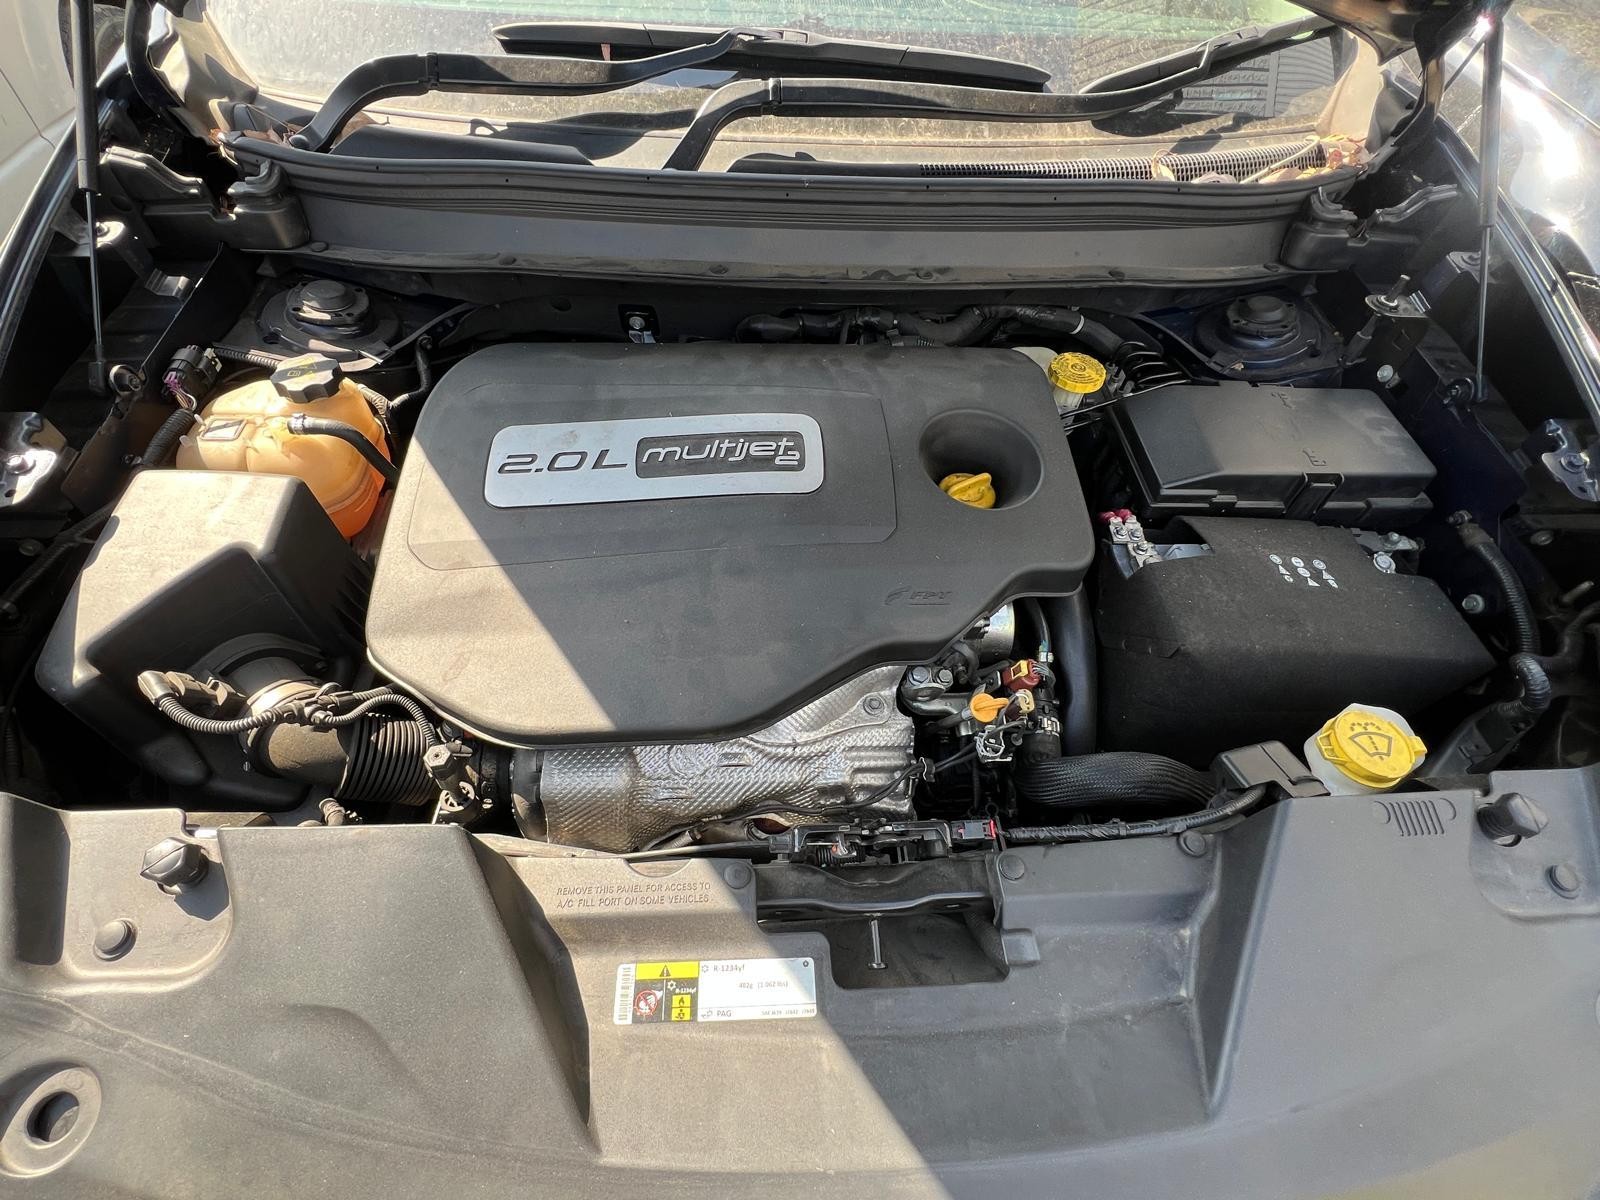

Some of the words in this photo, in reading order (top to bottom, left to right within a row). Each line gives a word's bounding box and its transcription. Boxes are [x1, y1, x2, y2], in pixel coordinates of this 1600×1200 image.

[498, 450, 627, 474] 2.0L
[641, 438, 794, 462] multijet
[556, 886, 593, 896] REMOVE
[595, 885, 614, 895] THIS
[616, 884, 643, 894] PANEL
[645, 883, 663, 893] FOR
[665, 882, 698, 892] ACCESS
[700, 881, 711, 890] TO
[557, 899, 574, 909] A/C
[577, 898, 596, 908] FILL
[598, 897, 621, 907] PORT
[625, 896, 638, 906] ON
[639, 895, 665, 905] SOME
[668, 894, 709, 904] VEHICLES
[713, 964, 745, 973] R-1234yf
[716, 1009, 732, 1018] PAG
